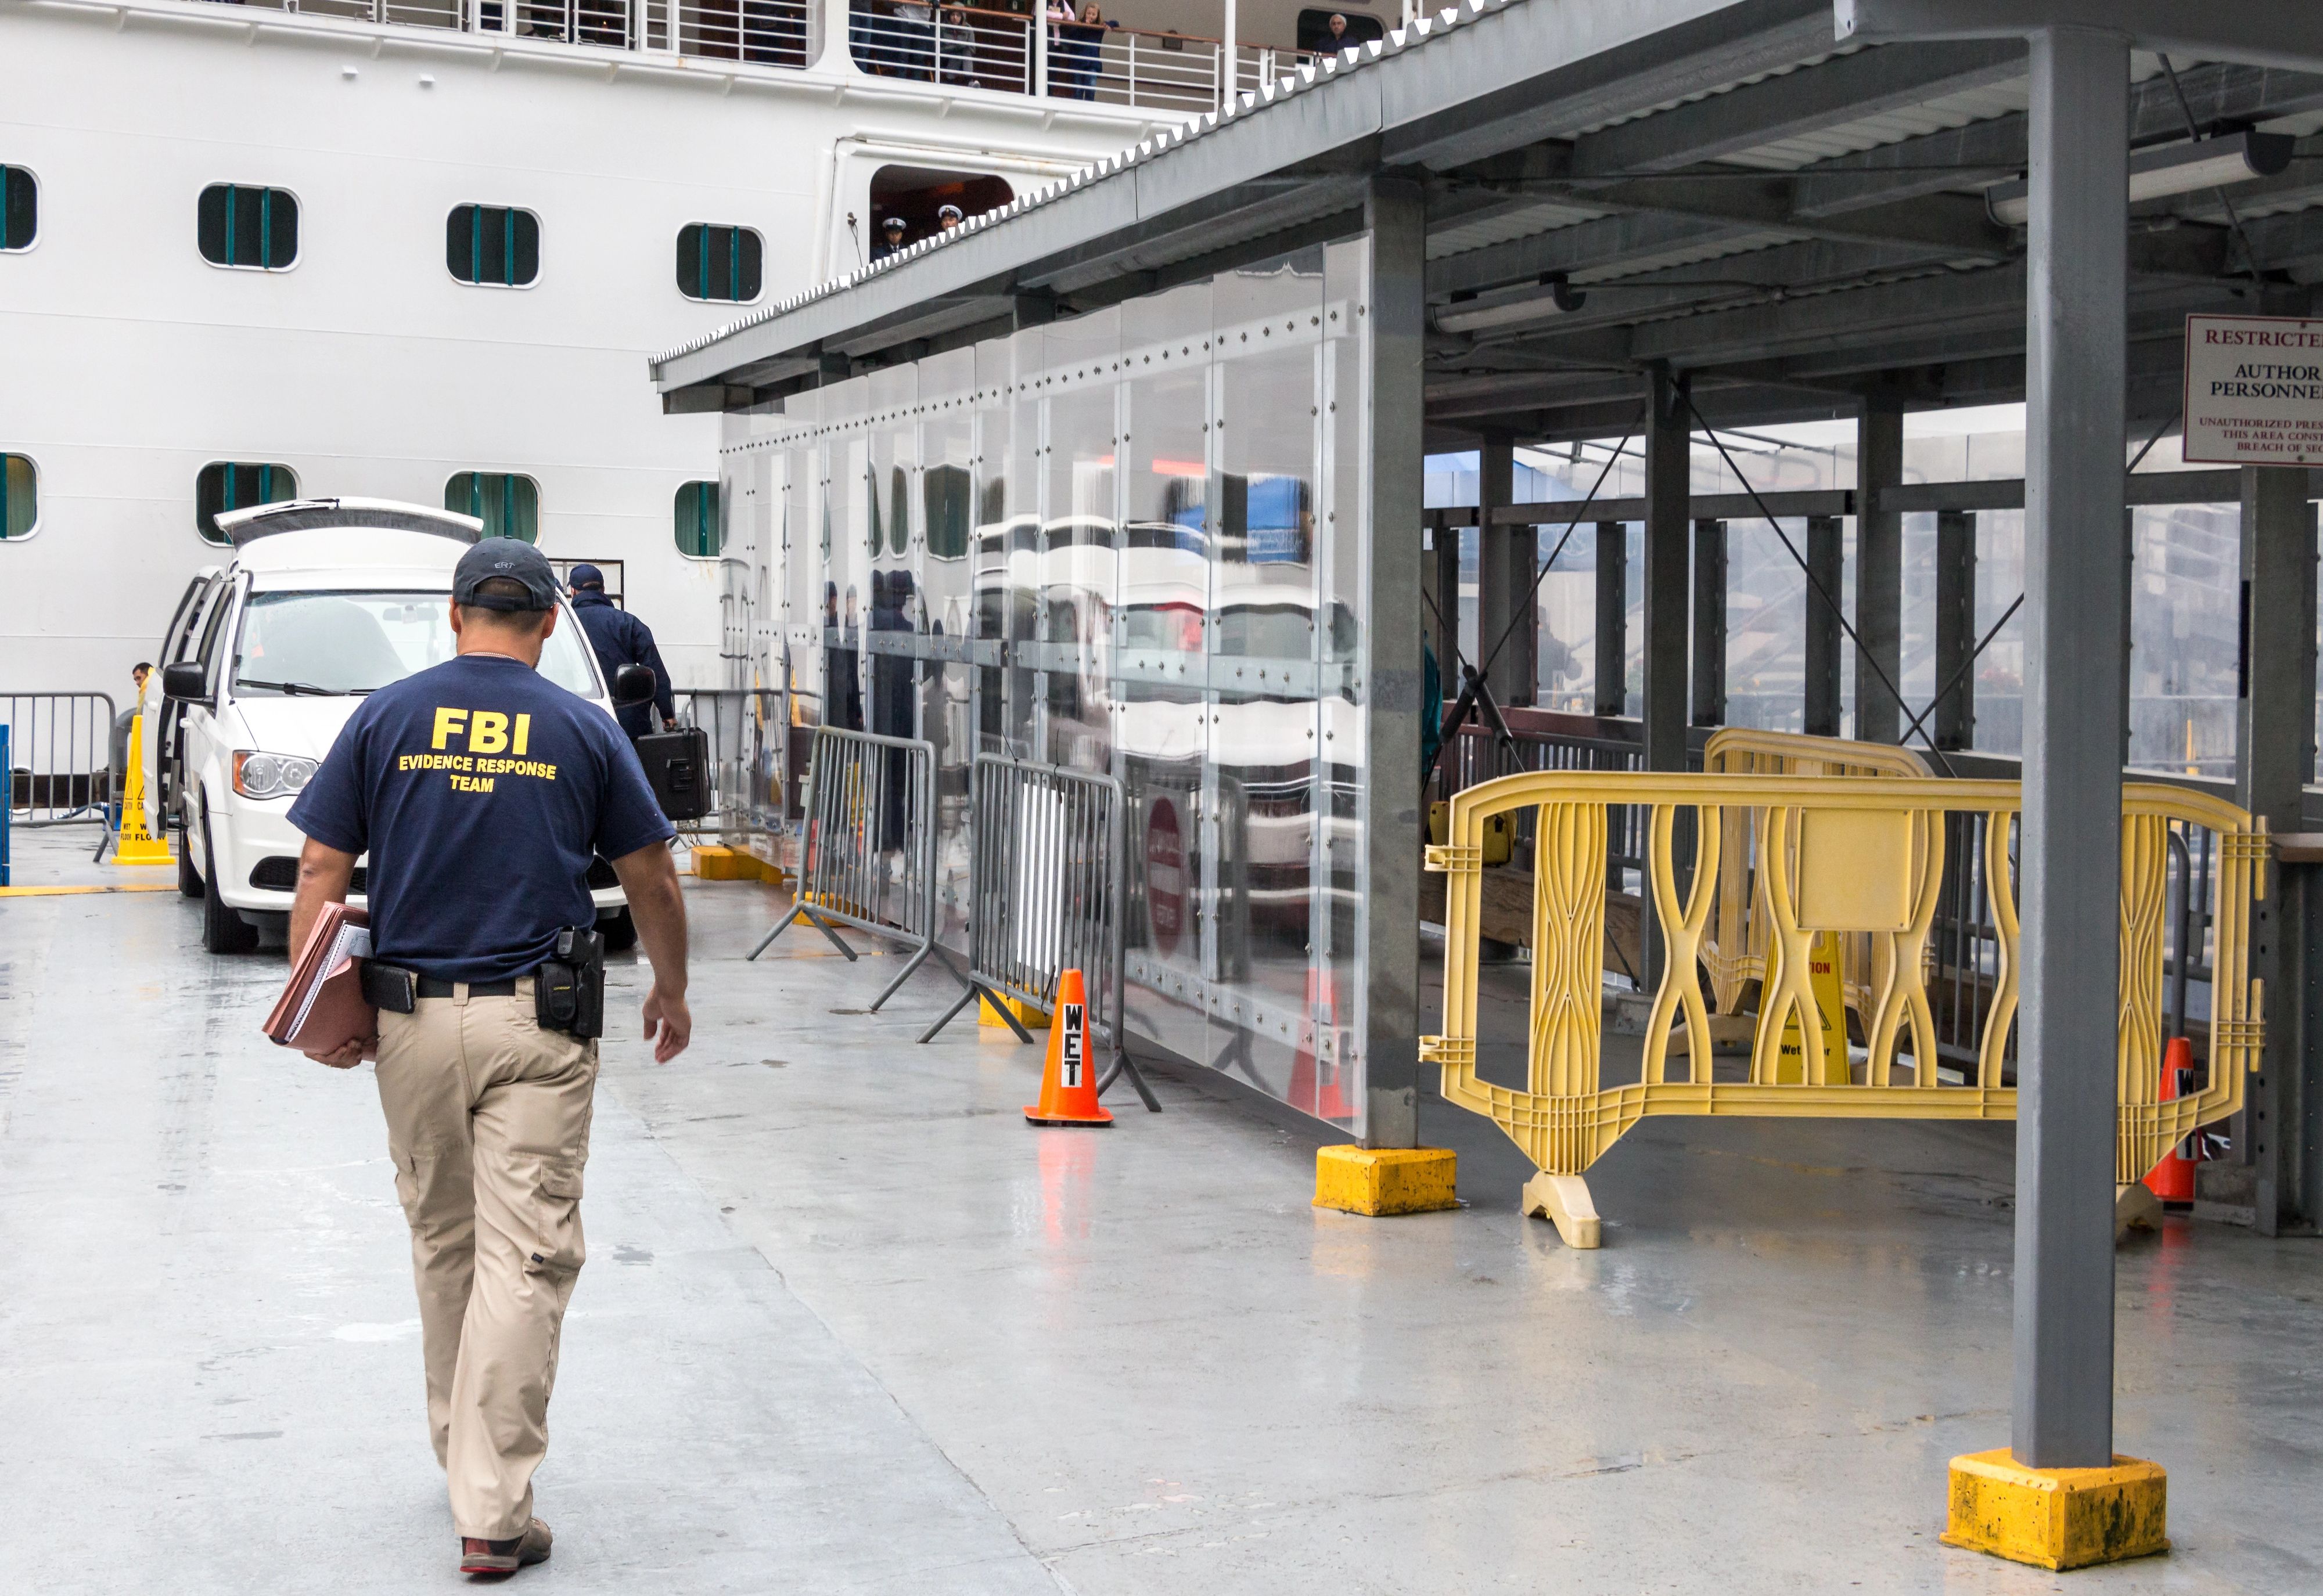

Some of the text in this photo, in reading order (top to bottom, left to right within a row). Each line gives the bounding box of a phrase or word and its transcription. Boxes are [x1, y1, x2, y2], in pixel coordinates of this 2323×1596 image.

[2206, 330, 2323, 347] RESTRICTE
[2236, 364, 2321, 381] AUTHOR
[2211, 381, 2323, 399] PERSONNE
[2199, 417, 2292, 428] UNAUTHORIZED
[2223, 430, 2248, 438] THIS
[2253, 431, 2284, 439] AREA
[2238, 442, 2283, 451] BREACH
[2288, 444, 2302, 452] OF
[431, 707, 531, 755] FBI
[399, 754, 557, 780] EVIDENCE RESPONSE
[450, 774, 494, 792] TEAM
[1809, 962, 1831, 974] ION
[1065, 1005, 1083, 1086] WET
[1781, 1044, 1801, 1055] Wet
